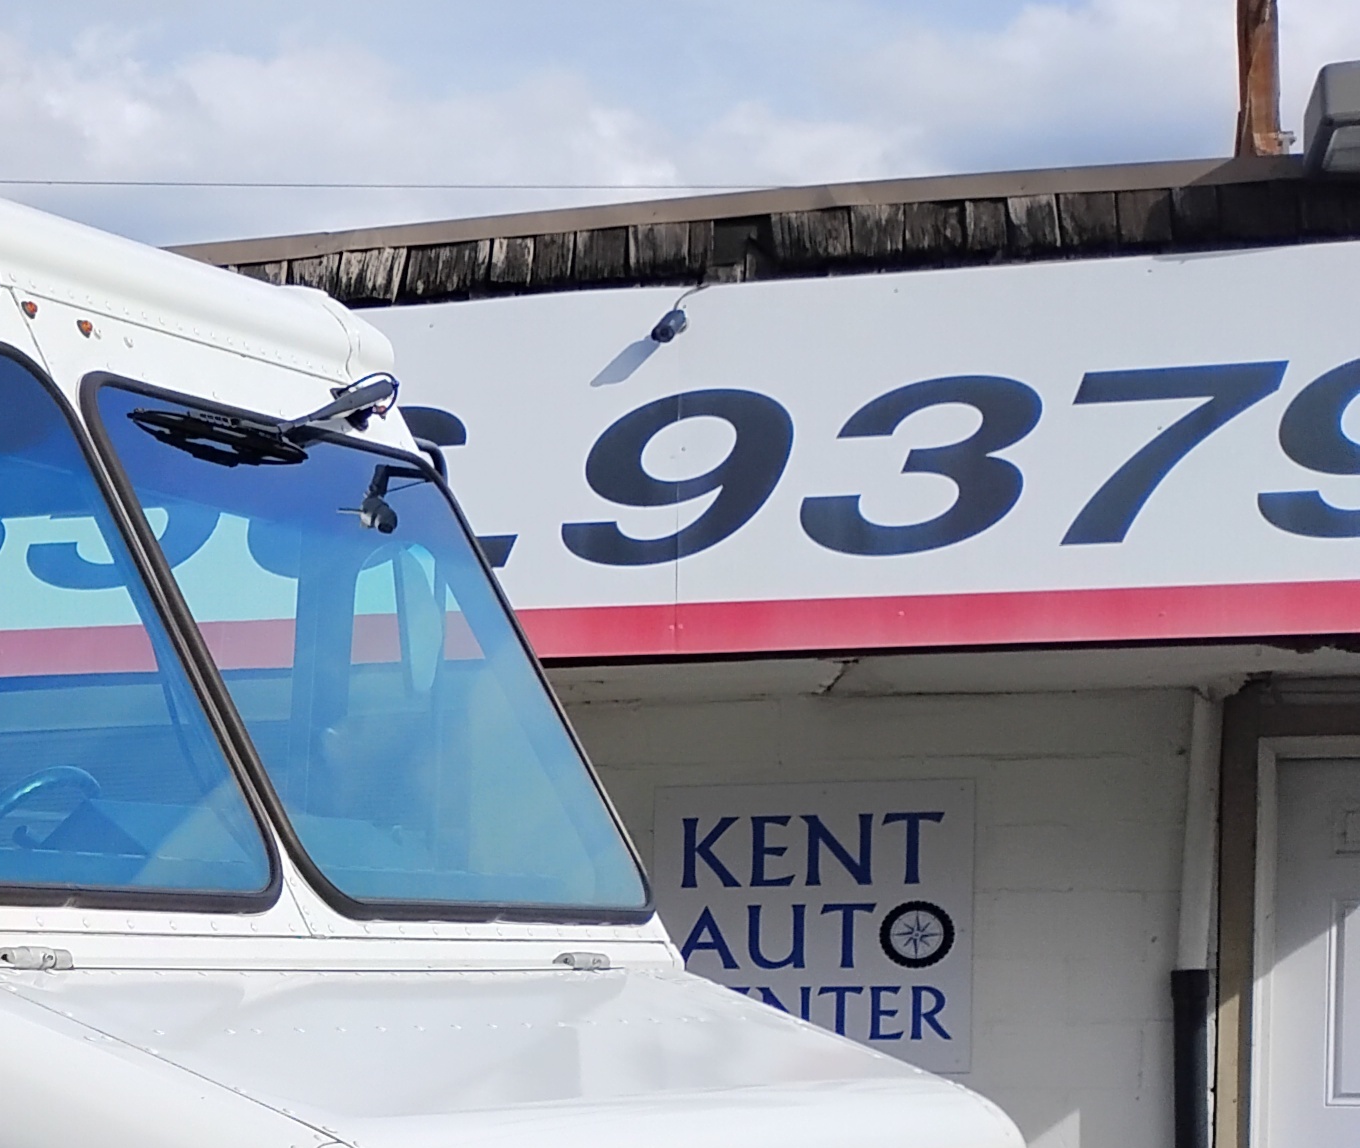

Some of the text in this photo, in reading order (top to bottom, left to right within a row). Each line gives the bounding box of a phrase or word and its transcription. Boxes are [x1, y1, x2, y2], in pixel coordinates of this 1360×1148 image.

[681, 812, 945, 888] KENT
[681, 901, 955, 969] AUTO
[726, 986, 952, 1040] NTER
